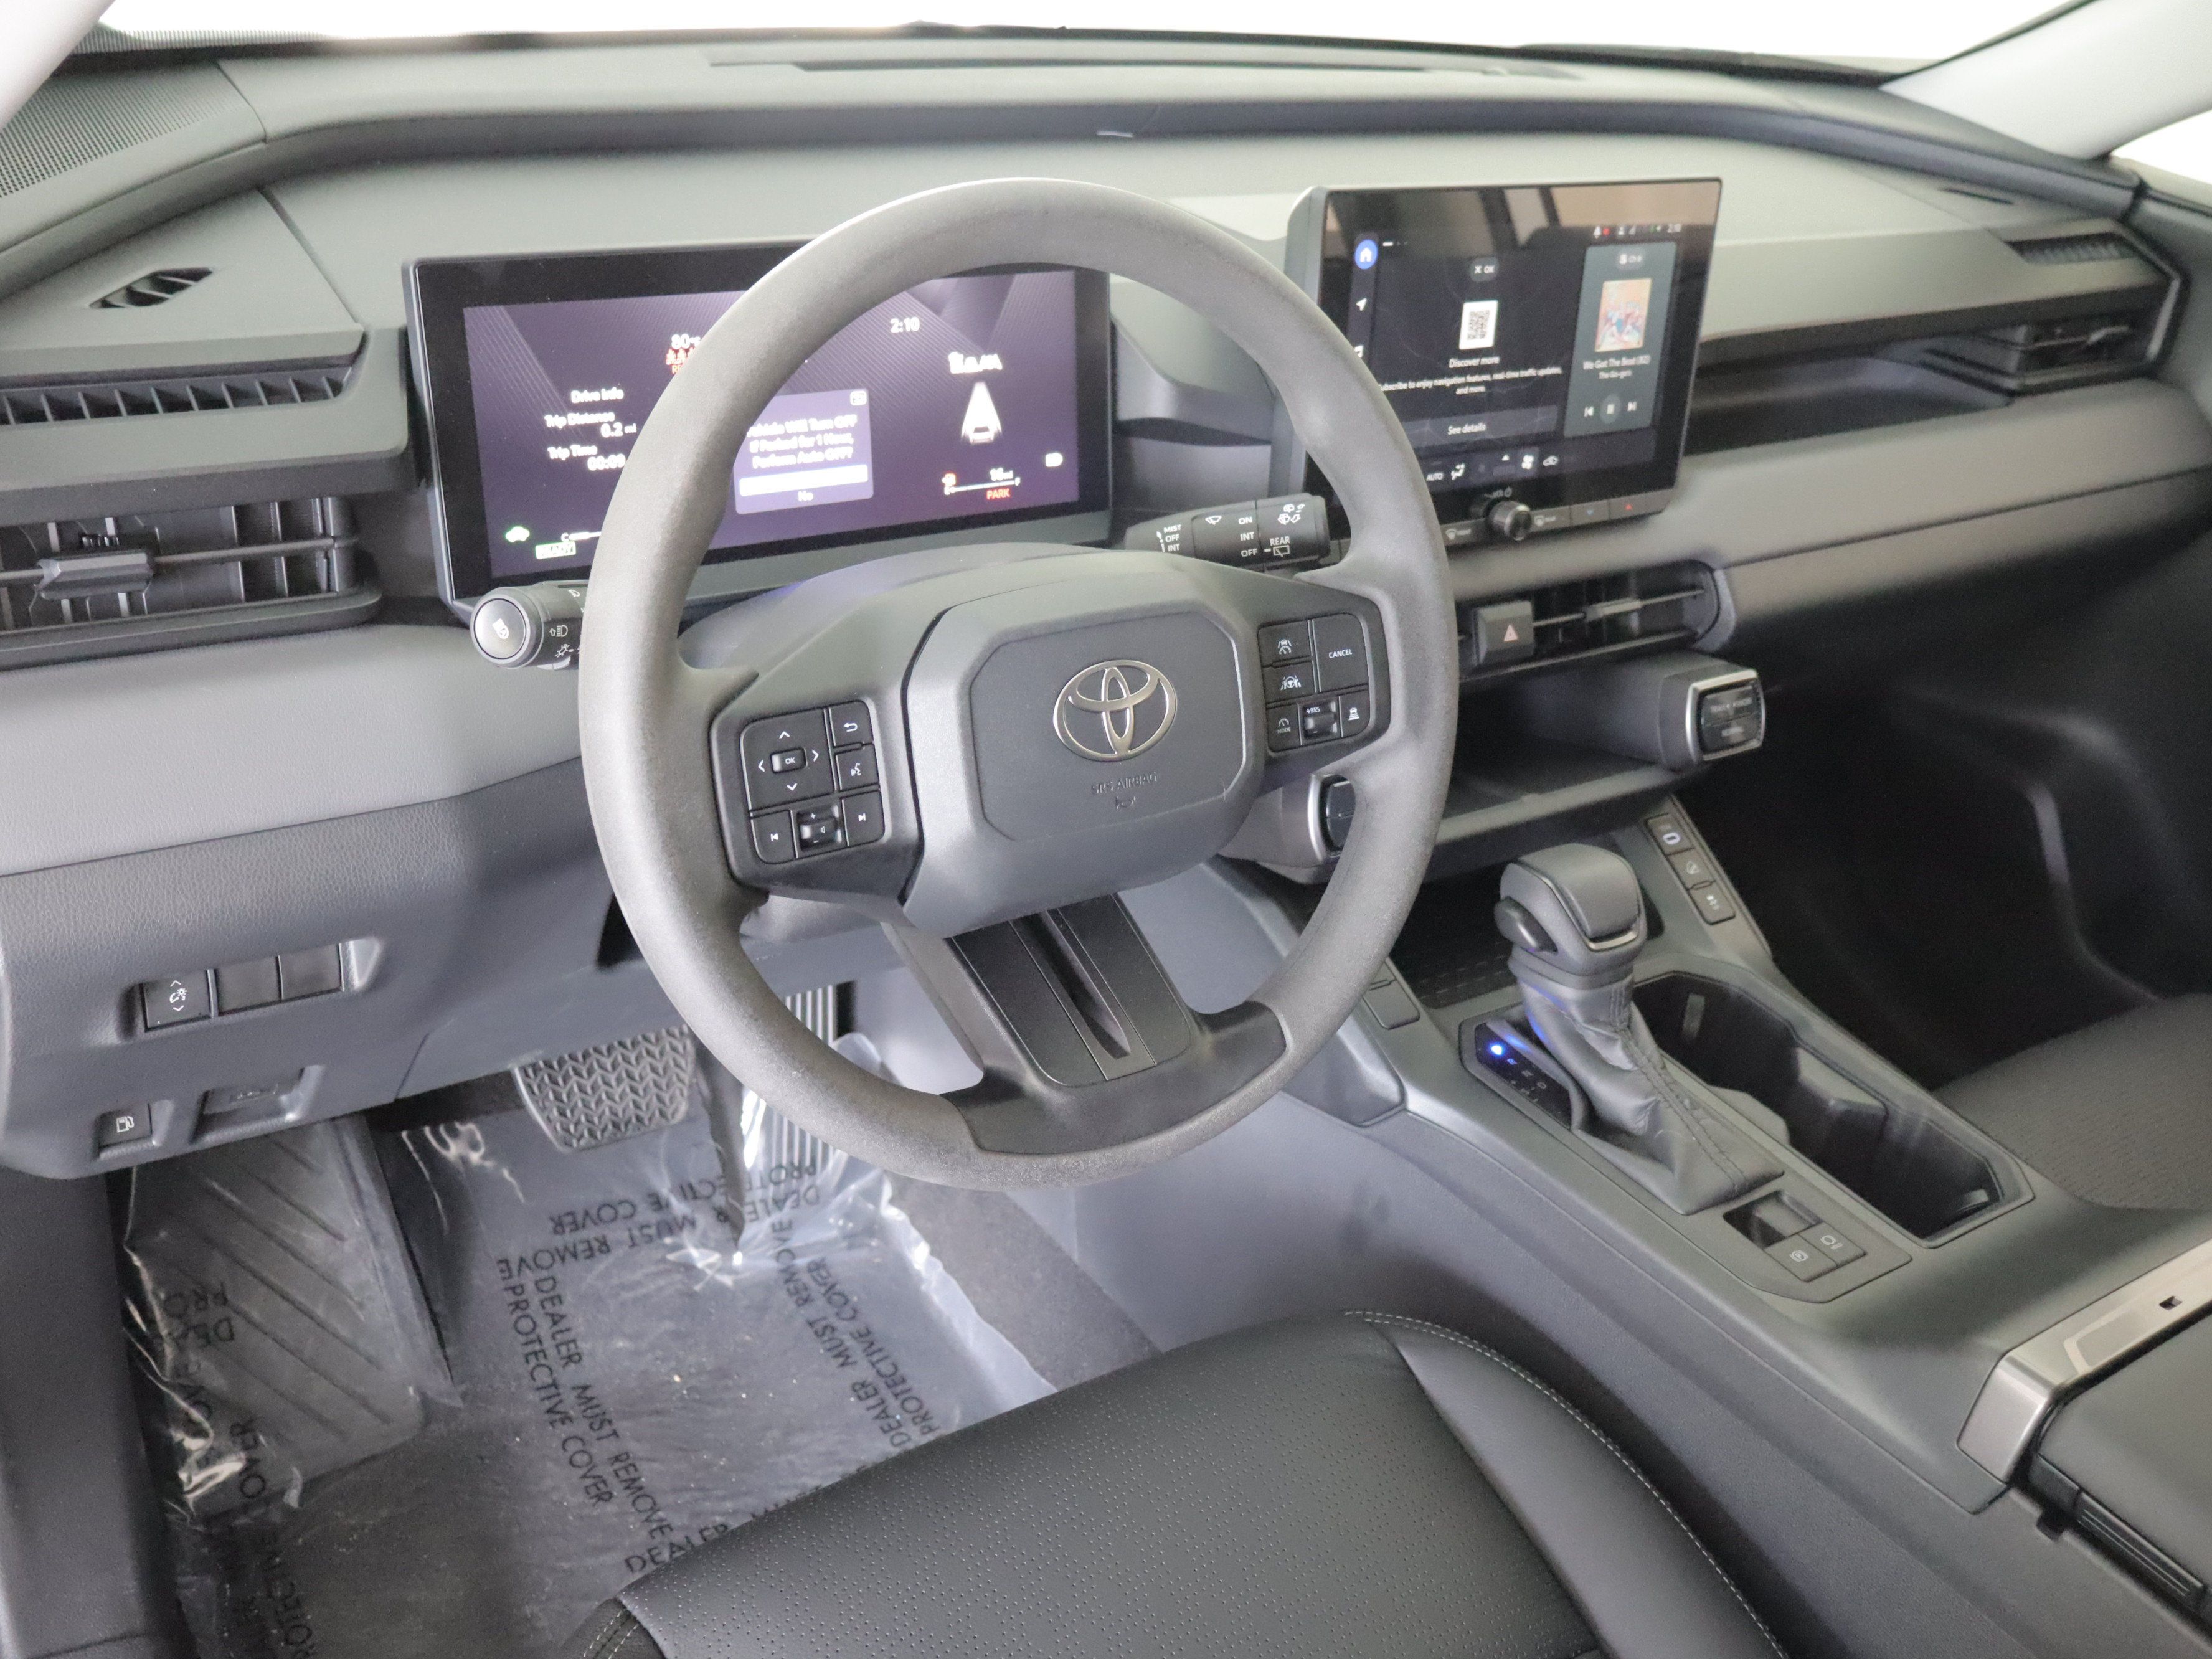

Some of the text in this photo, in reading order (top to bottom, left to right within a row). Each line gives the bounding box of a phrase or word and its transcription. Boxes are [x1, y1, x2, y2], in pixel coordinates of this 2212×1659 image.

[1449, 356, 1500, 368] Discover more
[1447, 422, 1486, 435] See details
[1427, 471, 1444, 481] AUTO
[986, 488, 1011, 500] PARK
[1238, 516, 1253, 526] ON
[1163, 524, 1182, 534] MIST
[1165, 534, 1180, 543] OFF
[1240, 531, 1255, 542] INT
[1269, 536, 1290, 546] REAR
[1167, 543, 1180, 552] INT
[1241, 547, 1258, 557] OFF
[1328, 648, 1353, 659] CANCEL
[1277, 726, 1292, 734] MODE
[785, 757, 796, 765] OK
[549, 1198, 637, 1237] COVER
[627, 1213, 697, 1250] MUST
[805, 1315, 858, 1369] MUST
[848, 1325, 942, 1436] PROTECTIVE
[503, 1283, 614, 1506] PROTECTIVE COVER
[535, 1275, 674, 1539] DEALER MUST REMOVE
[851, 1377, 912, 1448] DEALER
